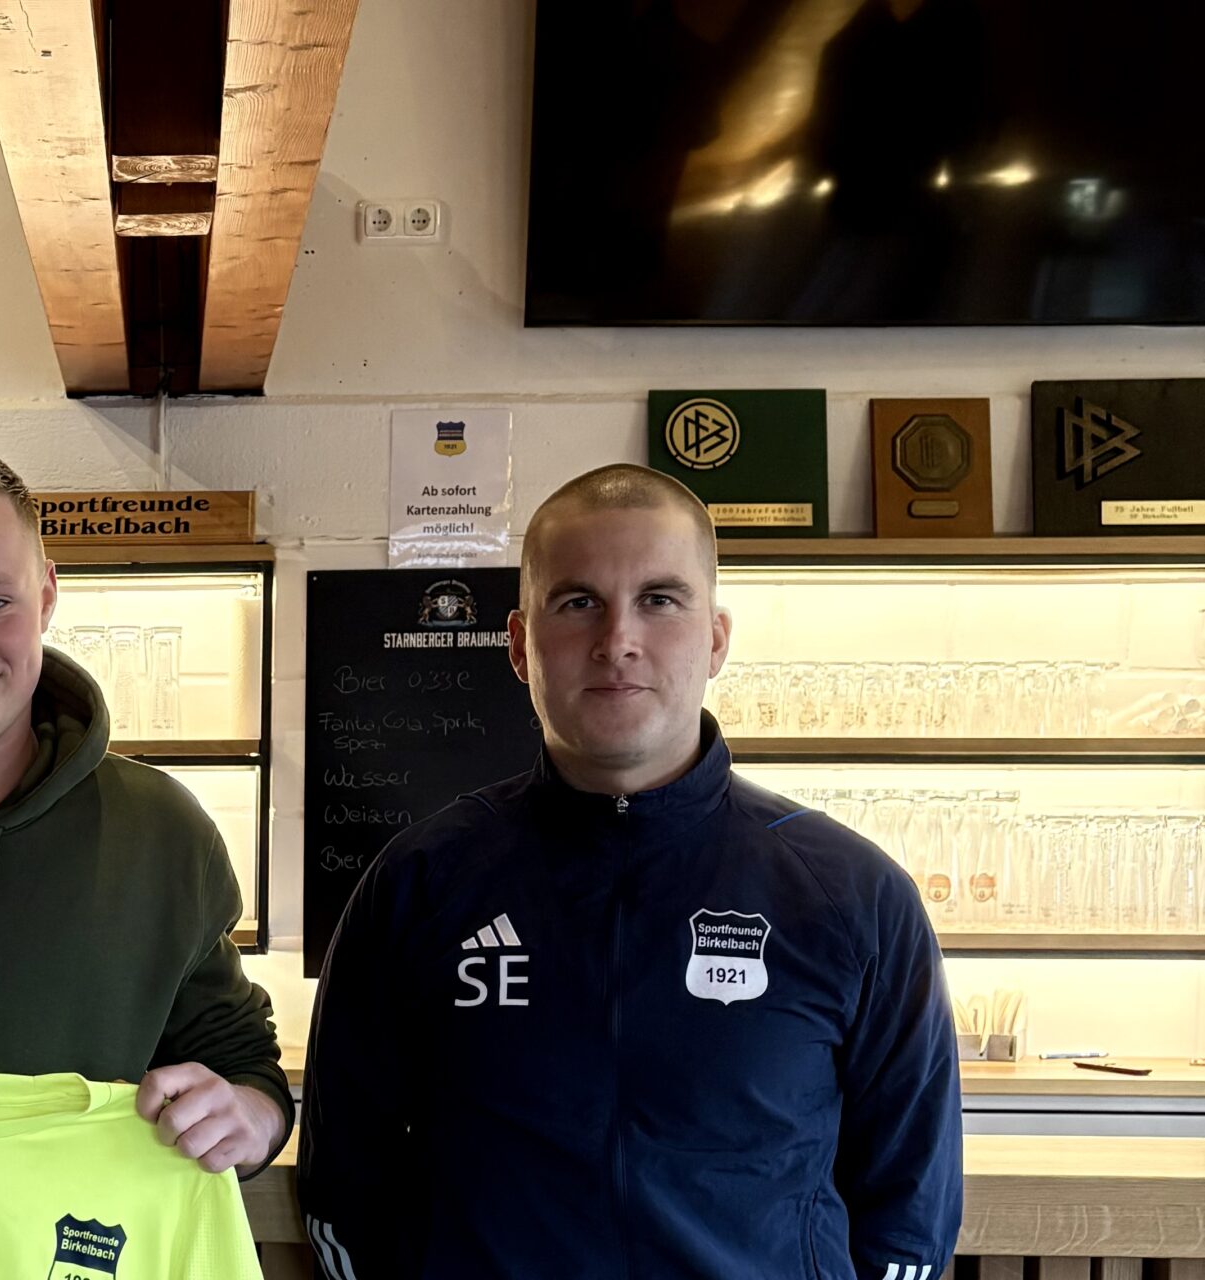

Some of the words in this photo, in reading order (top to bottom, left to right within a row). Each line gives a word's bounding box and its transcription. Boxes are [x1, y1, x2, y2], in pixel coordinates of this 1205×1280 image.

[421, 485, 438, 496] Ab
[441, 485, 477, 496] sofort
[406, 504, 492, 517] Kartenzahlung
[40, 516, 190, 536] Birkelbach
[423, 523, 474, 536] möglich!
[383, 632, 454, 648] STARNBERGER
[457, 631, 510, 647] BRAUHAUS
[333, 665, 386, 694] Bier
[324, 763, 411, 789] Wasser
[324, 804, 412, 825] Weizen
[320, 845, 364, 872] Bier
[698, 923, 763, 936] Sportfreunde
[697, 936, 760, 951] Birkelbach
[706, 967, 746, 985] 1921
[62, 1226, 120, 1247] Sportfreunde
[60, 1238, 115, 1261] Birkelbach
